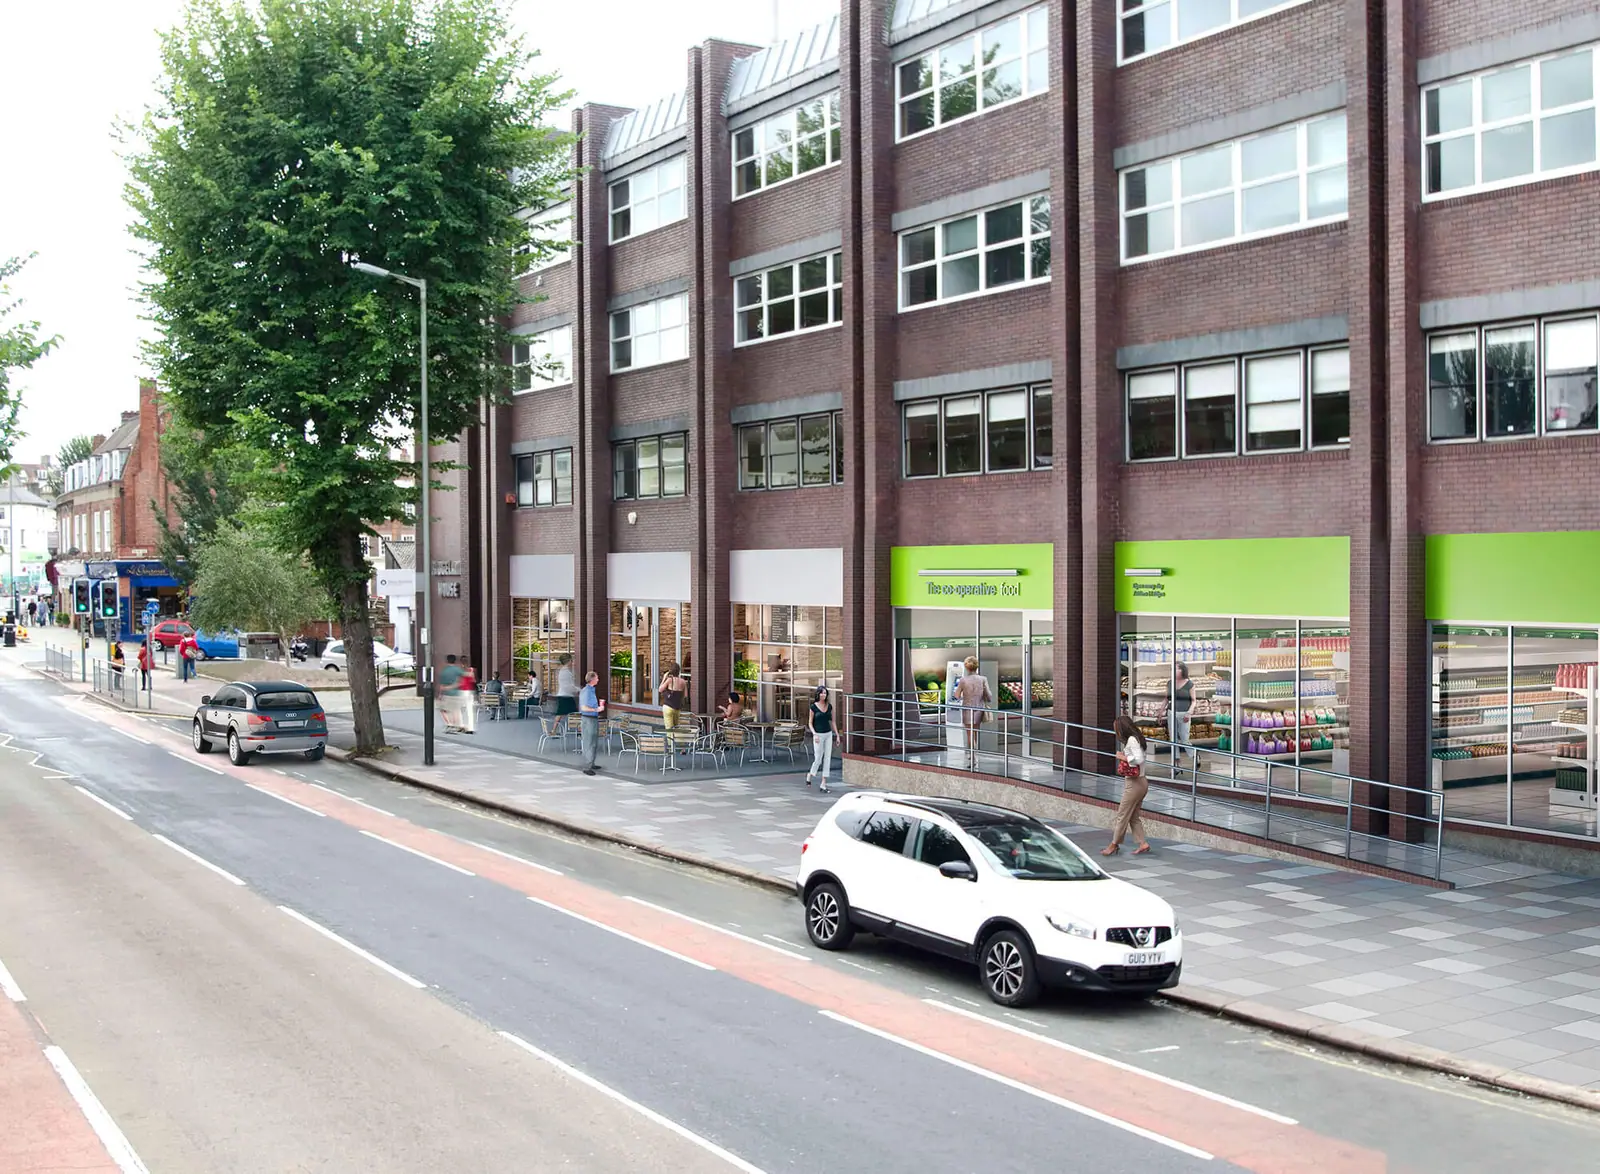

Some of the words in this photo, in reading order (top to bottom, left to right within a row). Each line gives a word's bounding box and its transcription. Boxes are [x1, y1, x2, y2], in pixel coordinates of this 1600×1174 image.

[926, 581, 941, 595] The
[942, 582, 997, 598] co-operative
[1000, 582, 1021, 596] food
[1128, 953, 1146, 964] GU13
